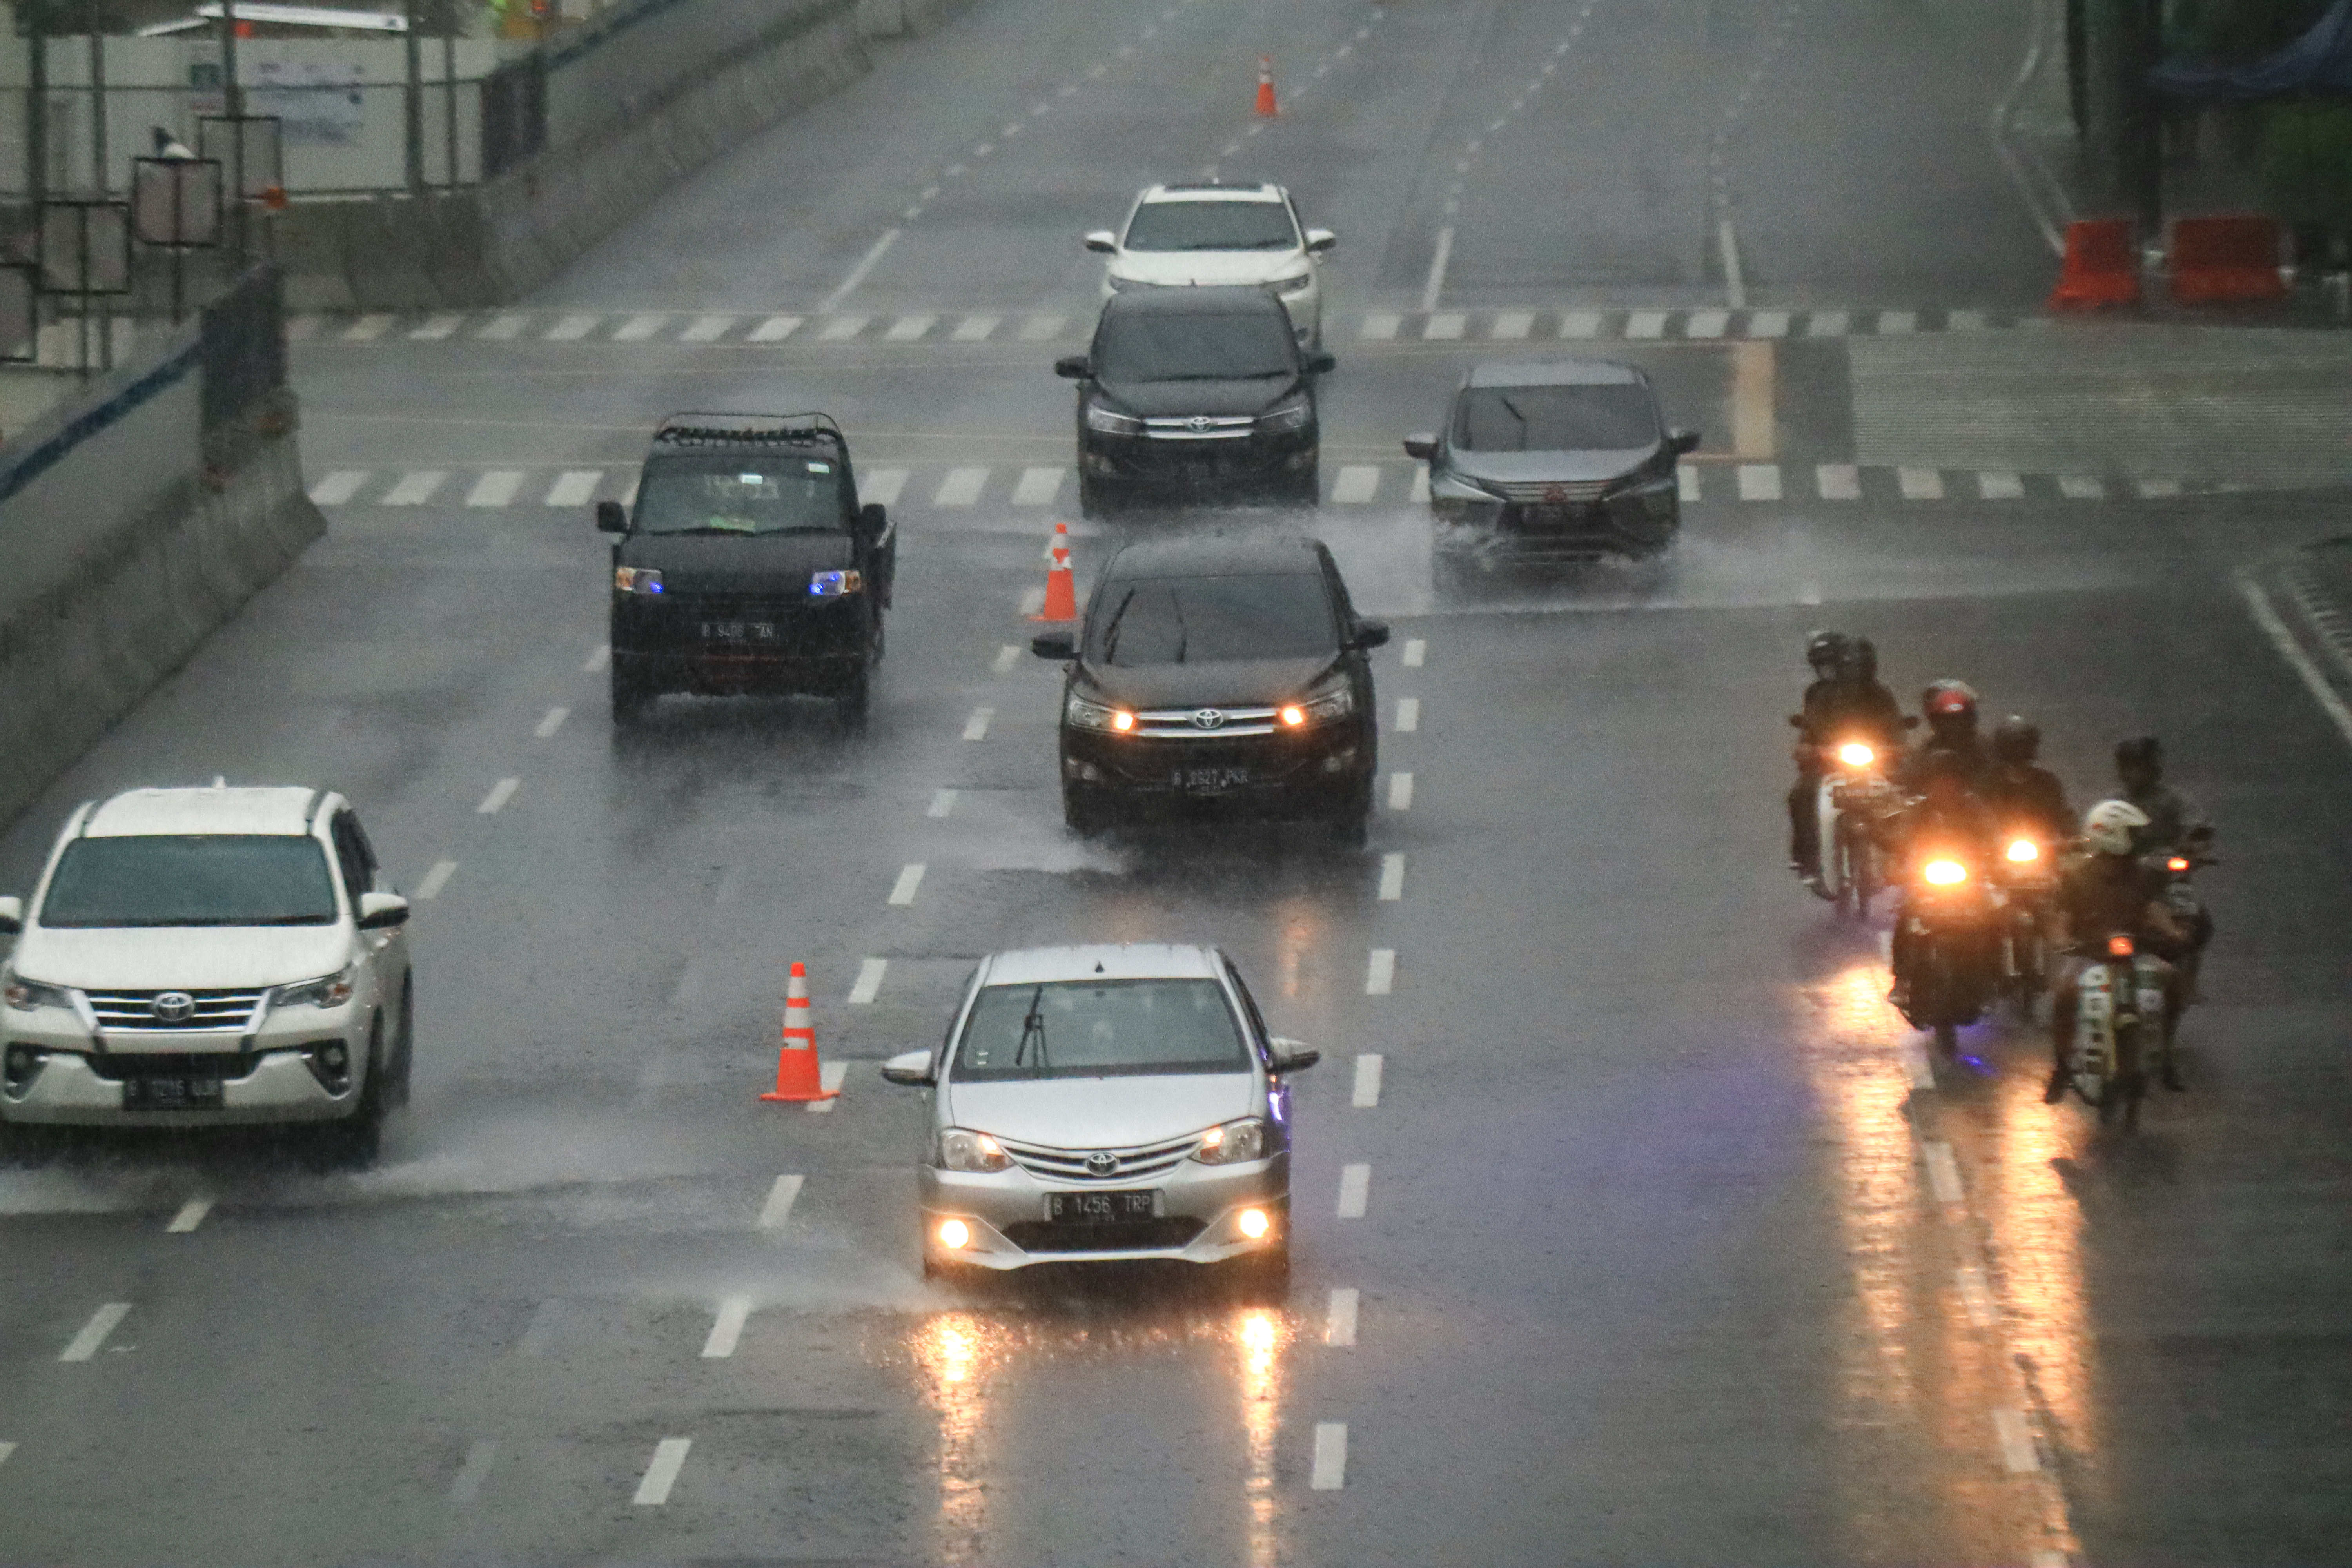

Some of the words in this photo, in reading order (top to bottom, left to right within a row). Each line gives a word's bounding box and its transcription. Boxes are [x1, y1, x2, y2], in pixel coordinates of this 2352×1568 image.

[1054, 1197, 1063, 1215] B
[1076, 1195, 1111, 1214] 1456
[1124, 1194, 1150, 1212] TRP
